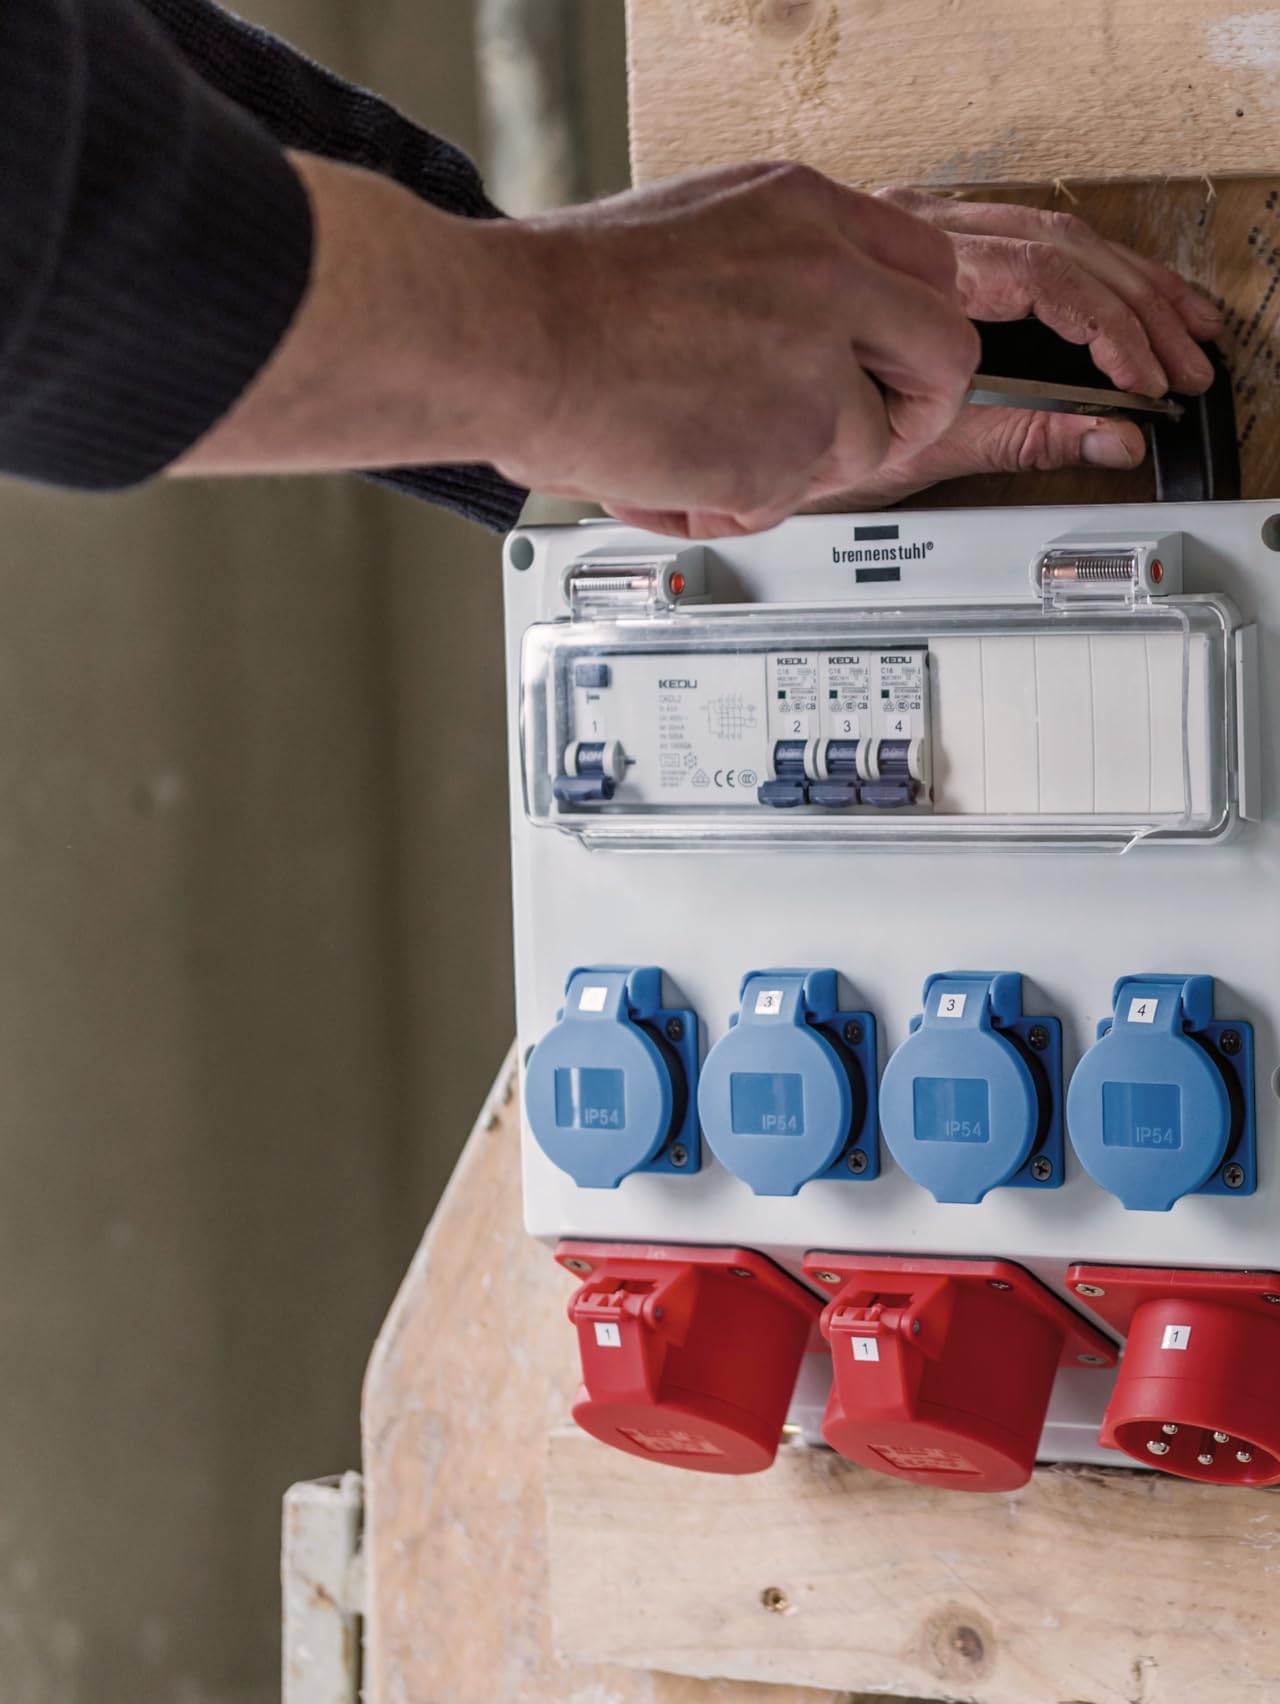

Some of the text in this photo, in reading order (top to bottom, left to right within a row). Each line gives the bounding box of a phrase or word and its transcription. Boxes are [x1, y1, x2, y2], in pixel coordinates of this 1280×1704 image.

[777, 657, 808, 666] KEDU
[828, 656, 860, 665] KEDU
[880, 655, 912, 665] KEDU
[658, 680, 698, 689] KEDU
[793, 719, 801, 733] 2
[843, 719, 852, 733] 3
[894, 719, 903, 733] 4
[946, 999, 956, 1012] 3
[1137, 1004, 1147, 1017] 4
[584, 1108, 619, 1125] IP54
[762, 1114, 797, 1131] IP54
[945, 1120, 982, 1138] IP54
[1135, 1127, 1175, 1144] IP54
